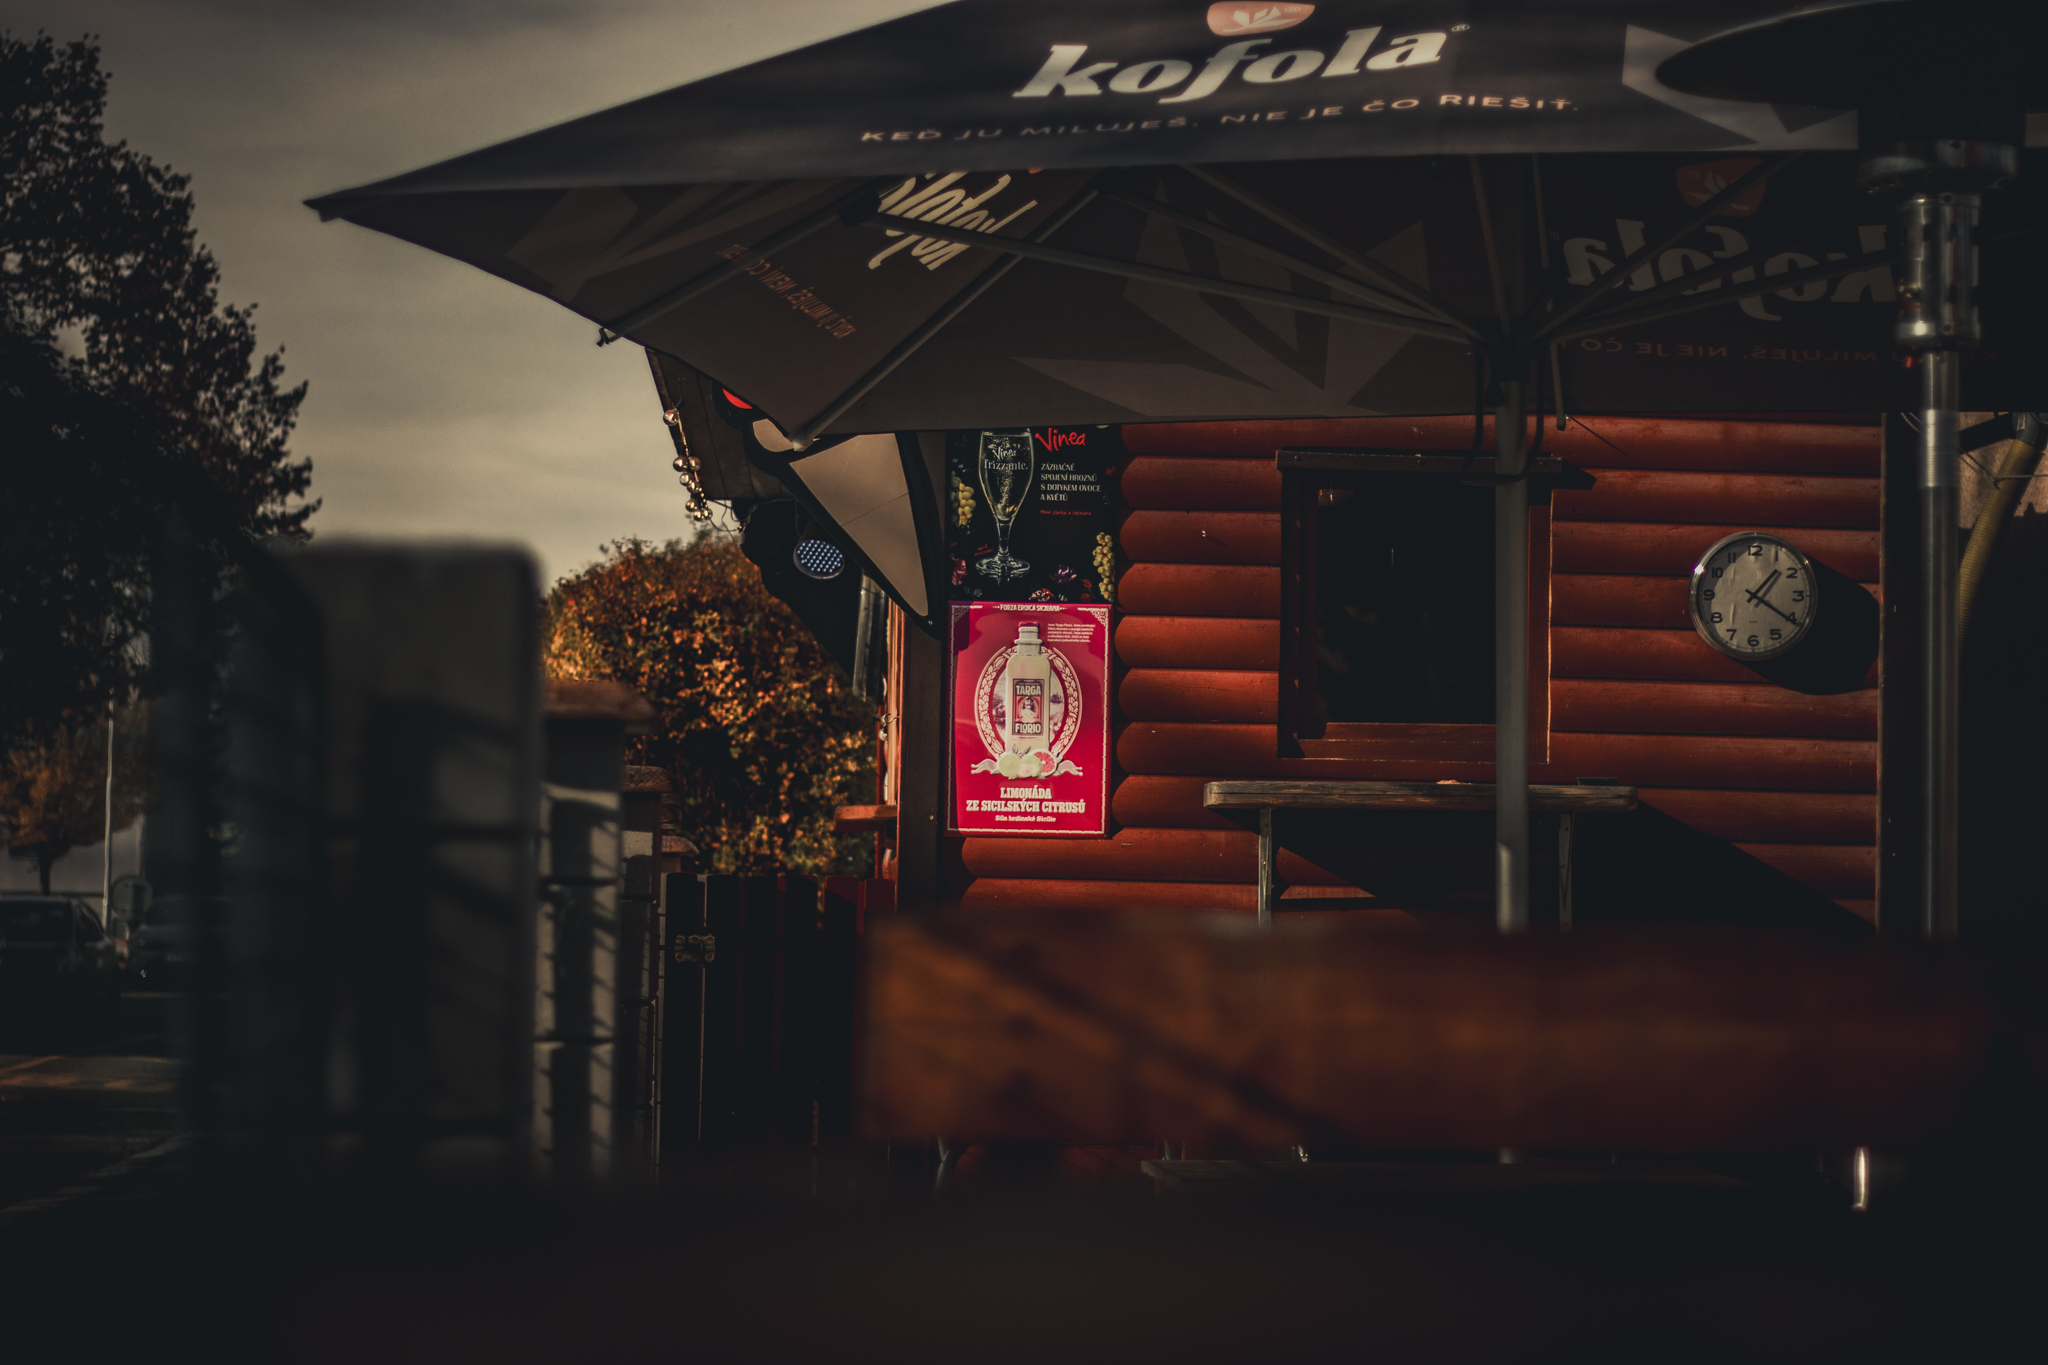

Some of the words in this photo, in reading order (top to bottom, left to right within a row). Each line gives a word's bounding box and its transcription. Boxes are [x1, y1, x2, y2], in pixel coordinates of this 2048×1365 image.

[1012, 26, 1447, 104] kofola
[861, 128, 942, 142] KEĎ
[953, 128, 1002, 140] JU
[1220, 110, 1288, 124] NIE
[1300, 105, 1344, 120] JE
[1362, 98, 1420, 112] ČO
[1034, 427, 1086, 453] Vinea
[991, 446, 1017, 460] Vinea
[1041, 462, 1076, 472] ZÁZRAČNÉ
[1040, 472, 1068, 482] SPOJENÍ
[1040, 483, 1046, 491] S
[1047, 484, 1078, 492] DOTYKEM
[1079, 484, 1102, 493] OVOCE
[1040, 493, 1046, 501] A
[1046, 492, 1069, 502] KVĚTŮ
[1748, 545, 1763, 556] 12
[1728, 552, 1736, 563] 11
[1711, 567, 1723, 579] 10
[1786, 567, 1798, 579] 2
[1703, 589, 1715, 601] 9
[1792, 590, 1805, 602] 3
[1017, 604, 1036, 612] EROICA
[1710, 612, 1723, 624] 8
[1786, 611, 1798, 624] 4
[1726, 629, 1737, 641] 7
[1770, 629, 1782, 640] 5
[1747, 635, 1760, 647] 6
[1016, 685, 1041, 696] TARGA
[1015, 723, 1041, 734] FLORIO
[1000, 785, 1052, 799] LIMONÁDA
[966, 800, 980, 812] ZE
[981, 797, 1041, 813] SICILSKÝCH
[1042, 799, 1086, 814] CITRUSŮ
